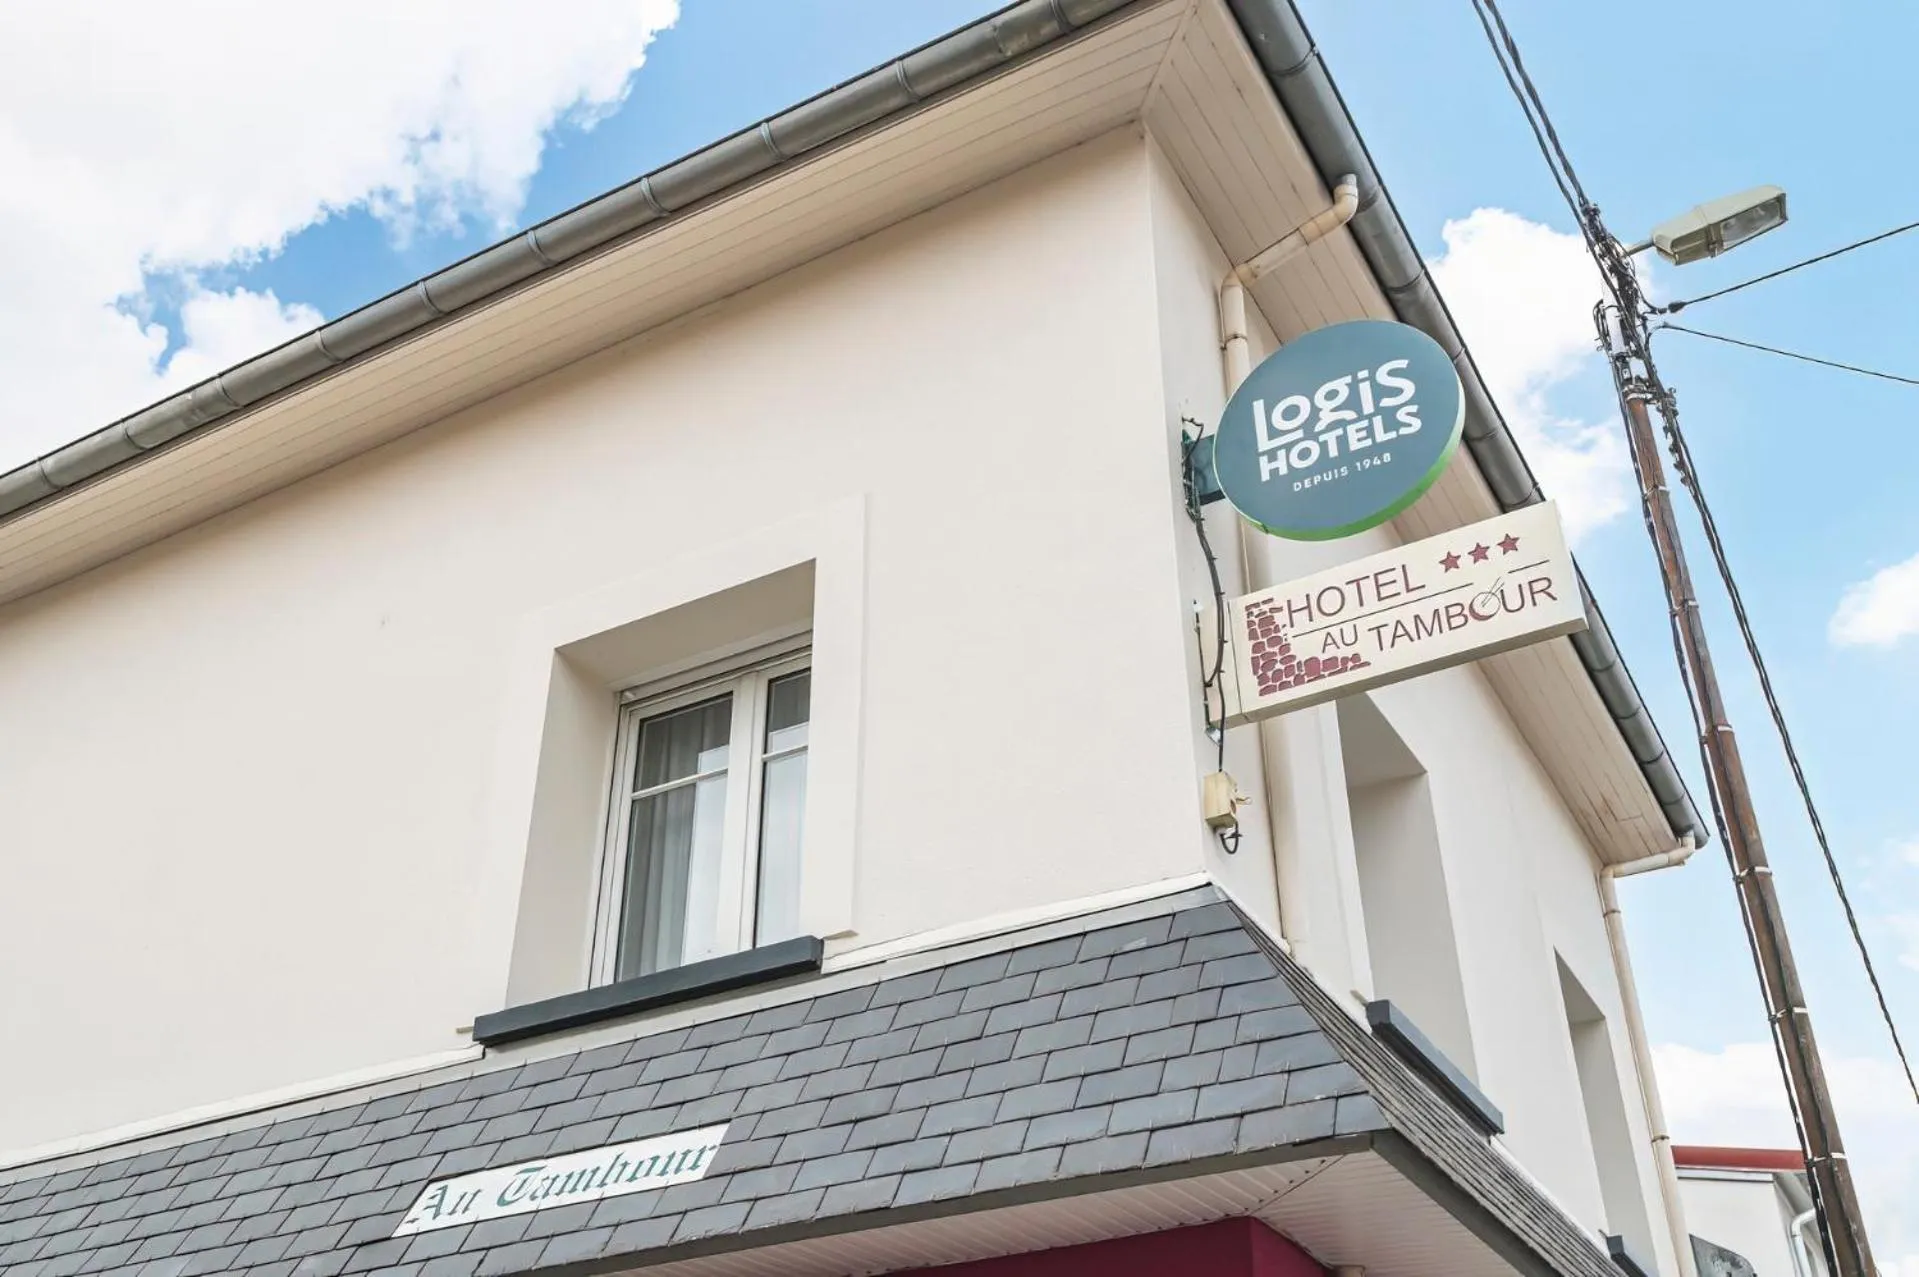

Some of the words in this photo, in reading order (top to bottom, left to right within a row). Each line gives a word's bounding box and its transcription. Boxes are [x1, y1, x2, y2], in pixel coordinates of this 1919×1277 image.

[1259, 405, 1423, 482] HOTELS
[1293, 466, 1349, 492] DEPUIS
[1355, 453, 1392, 472] 1948
[1287, 564, 1426, 627] HOTEL
[1322, 624, 1359, 654] AU
[1367, 576, 1558, 652] TAMBOUR
[405, 1184, 483, 1222] Au
[496, 1144, 719, 1207] Tambour
